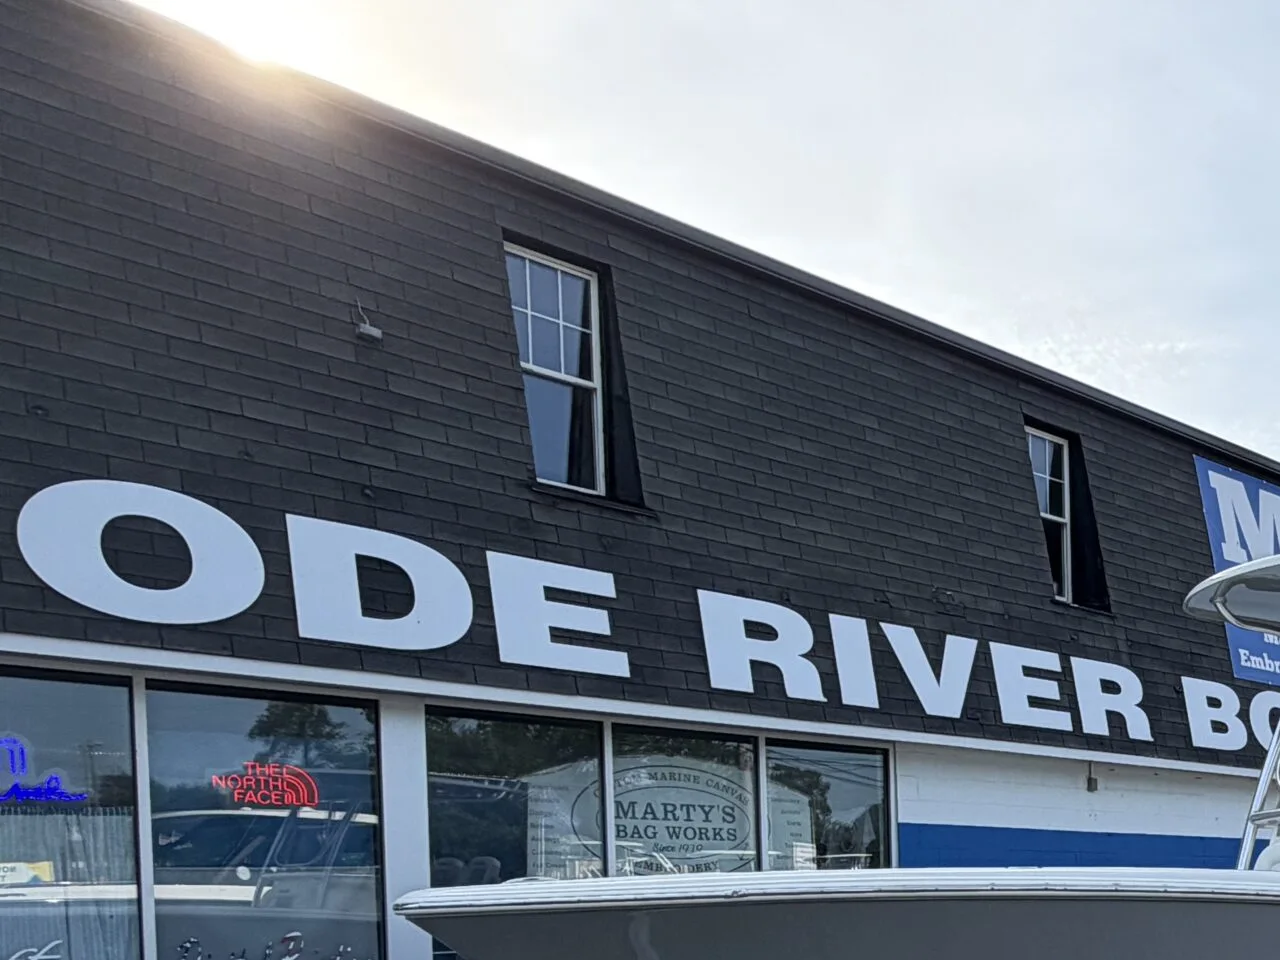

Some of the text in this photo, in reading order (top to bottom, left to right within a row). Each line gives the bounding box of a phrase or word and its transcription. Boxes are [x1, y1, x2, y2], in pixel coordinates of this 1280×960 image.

[17, 479, 629, 677] ODE
[697, 589, 1154, 742] RIVER
[242, 762, 280, 776] THE
[211, 774, 283, 790] NORTH
[649, 772, 700, 785] MARINE
[233, 789, 283, 805] FACE
[613, 801, 736, 824] MARTY'S
[614, 824, 737, 842] BAG WORKS
